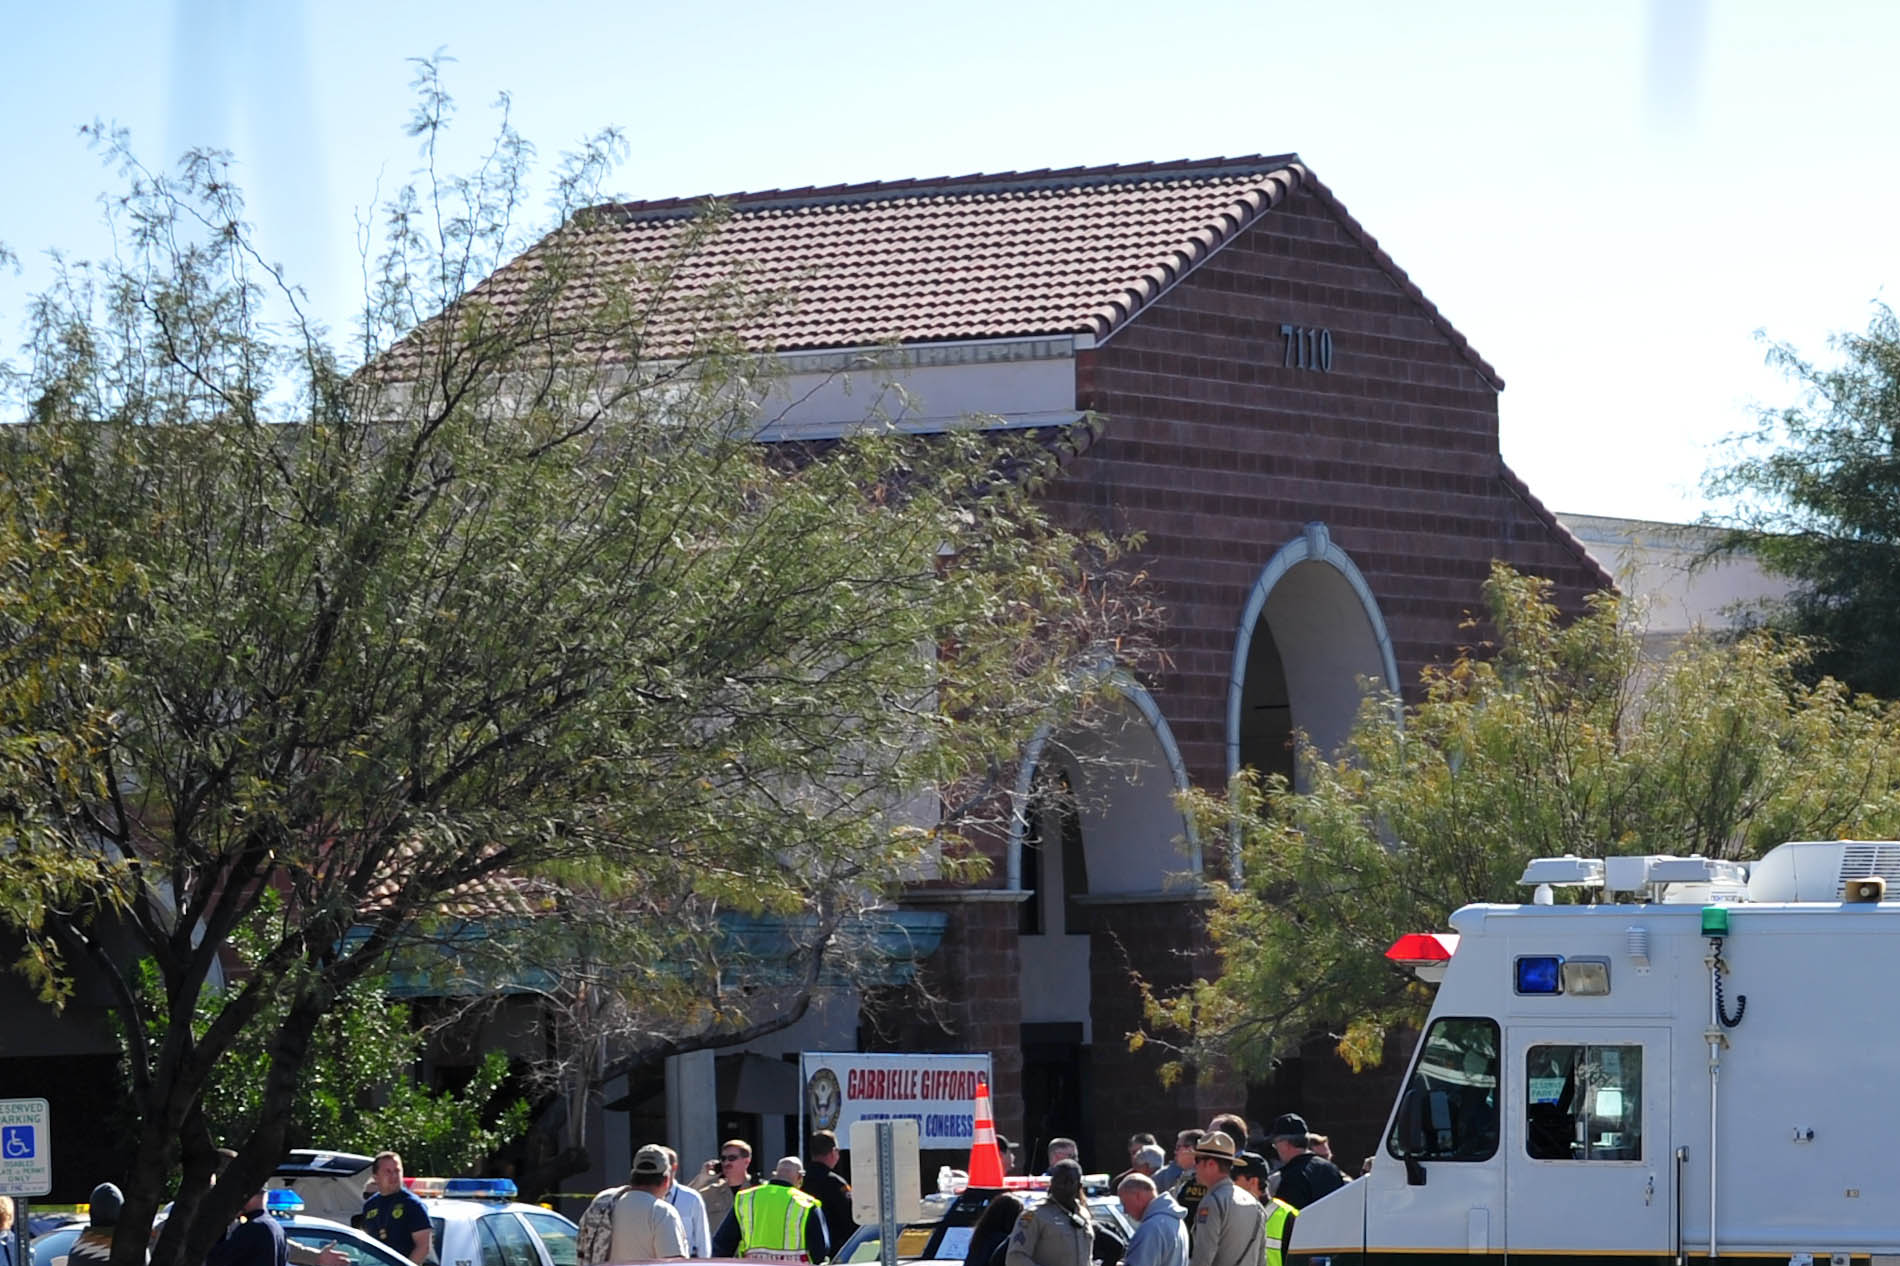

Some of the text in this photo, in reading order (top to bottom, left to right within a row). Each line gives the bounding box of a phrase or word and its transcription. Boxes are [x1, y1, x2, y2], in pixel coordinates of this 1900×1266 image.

[1280, 324, 1333, 374] 7110
[847, 1068, 918, 1100] GABRIELLE
[0, 1103, 43, 1114] ESERVED
[0, 1114, 41, 1124] ARKING
[925, 1114, 974, 1137] CONGRESS
[1185, 1186, 1206, 1197] POLI
